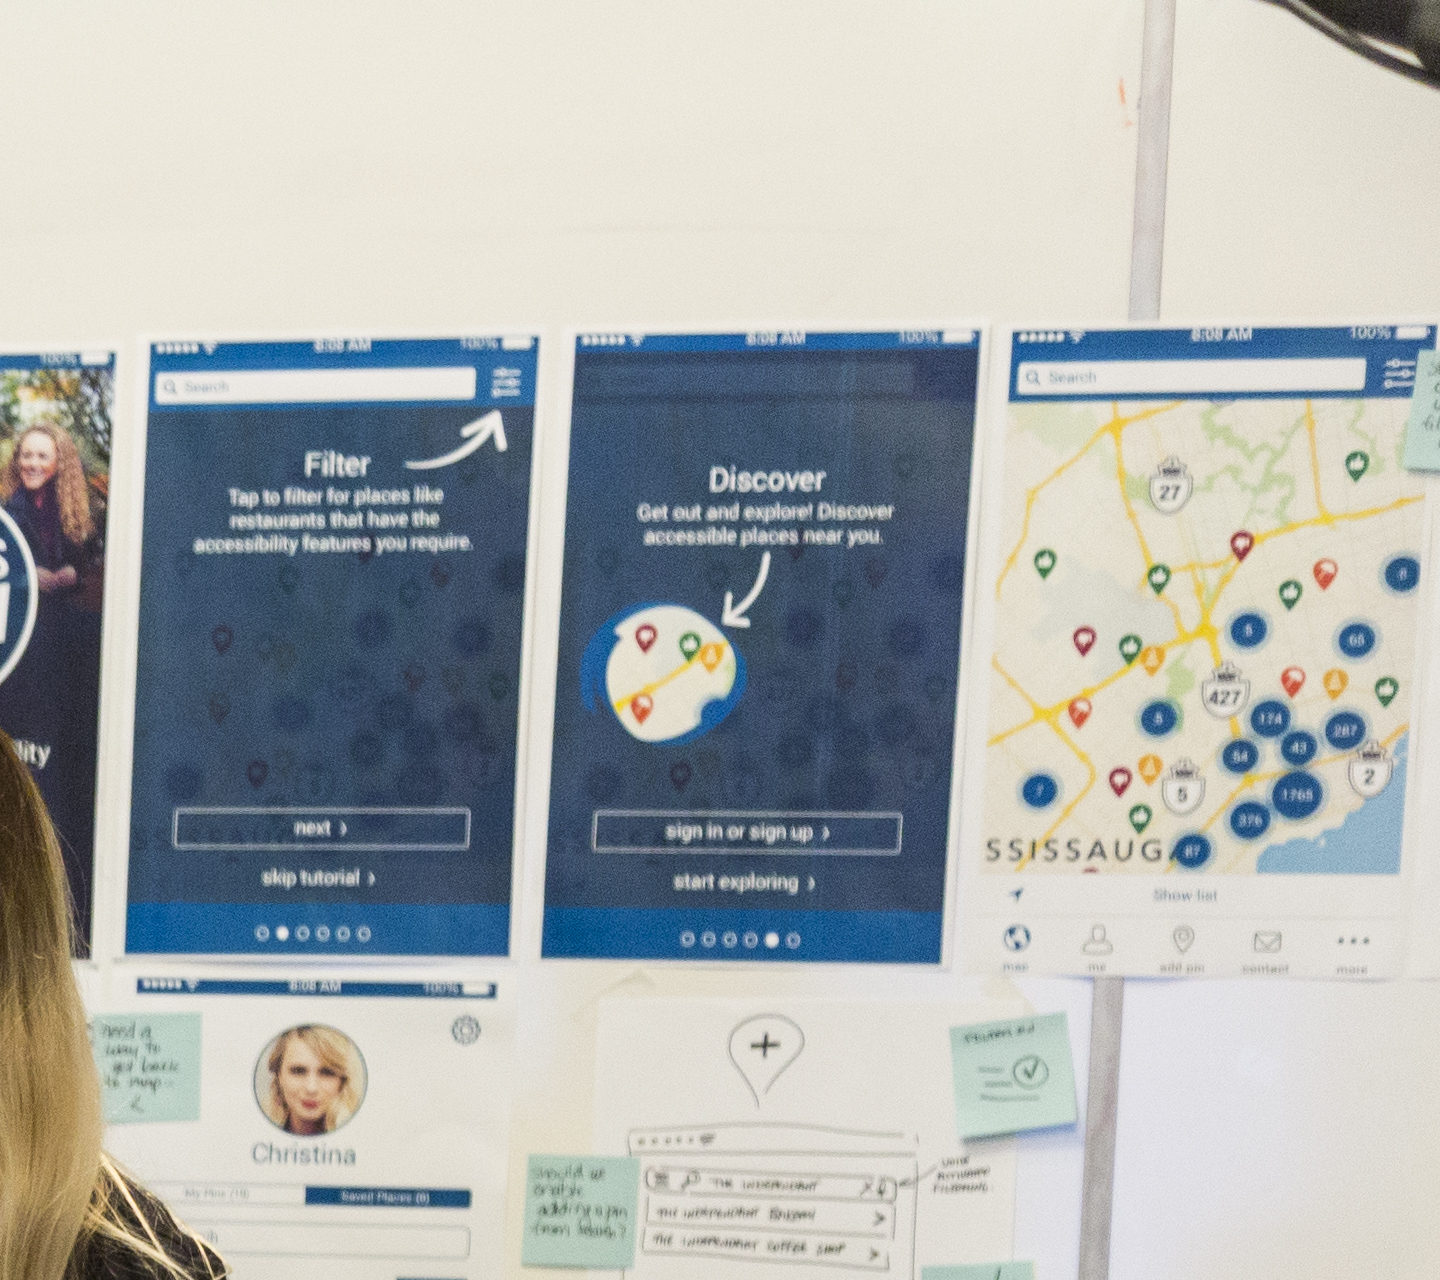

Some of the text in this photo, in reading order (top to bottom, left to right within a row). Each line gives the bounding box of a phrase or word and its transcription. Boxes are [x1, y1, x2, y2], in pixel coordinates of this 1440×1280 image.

[777, 332, 806, 346] AM
[1224, 326, 1253, 342] AM
[1351, 325, 1392, 339] 100%
[344, 339, 372, 352] AM
[185, 379, 230, 394] Search
[1048, 369, 1097, 385] Search
[304, 451, 372, 478] Filter
[709, 467, 827, 493] Discover
[229, 486, 444, 507] Tap to filter for places like
[1160, 484, 1180, 500] 27
[229, 510, 440, 529] restaurants that have the
[636, 502, 894, 525] Get out and explore! Discover
[193, 532, 474, 555] accessibility features you require.
[644, 526, 884, 549] accessible places near you.
[1209, 690, 1241, 705] 427
[1364, 769, 1375, 784] 2
[294, 819, 332, 838] next
[666, 822, 814, 844] sign in or sign up
[262, 868, 361, 889] skip tutorial
[674, 872, 799, 895] start exploring
[1153, 888, 1218, 902] Show list
[320, 980, 341, 994] AM
[251, 1142, 357, 1166] Christina
